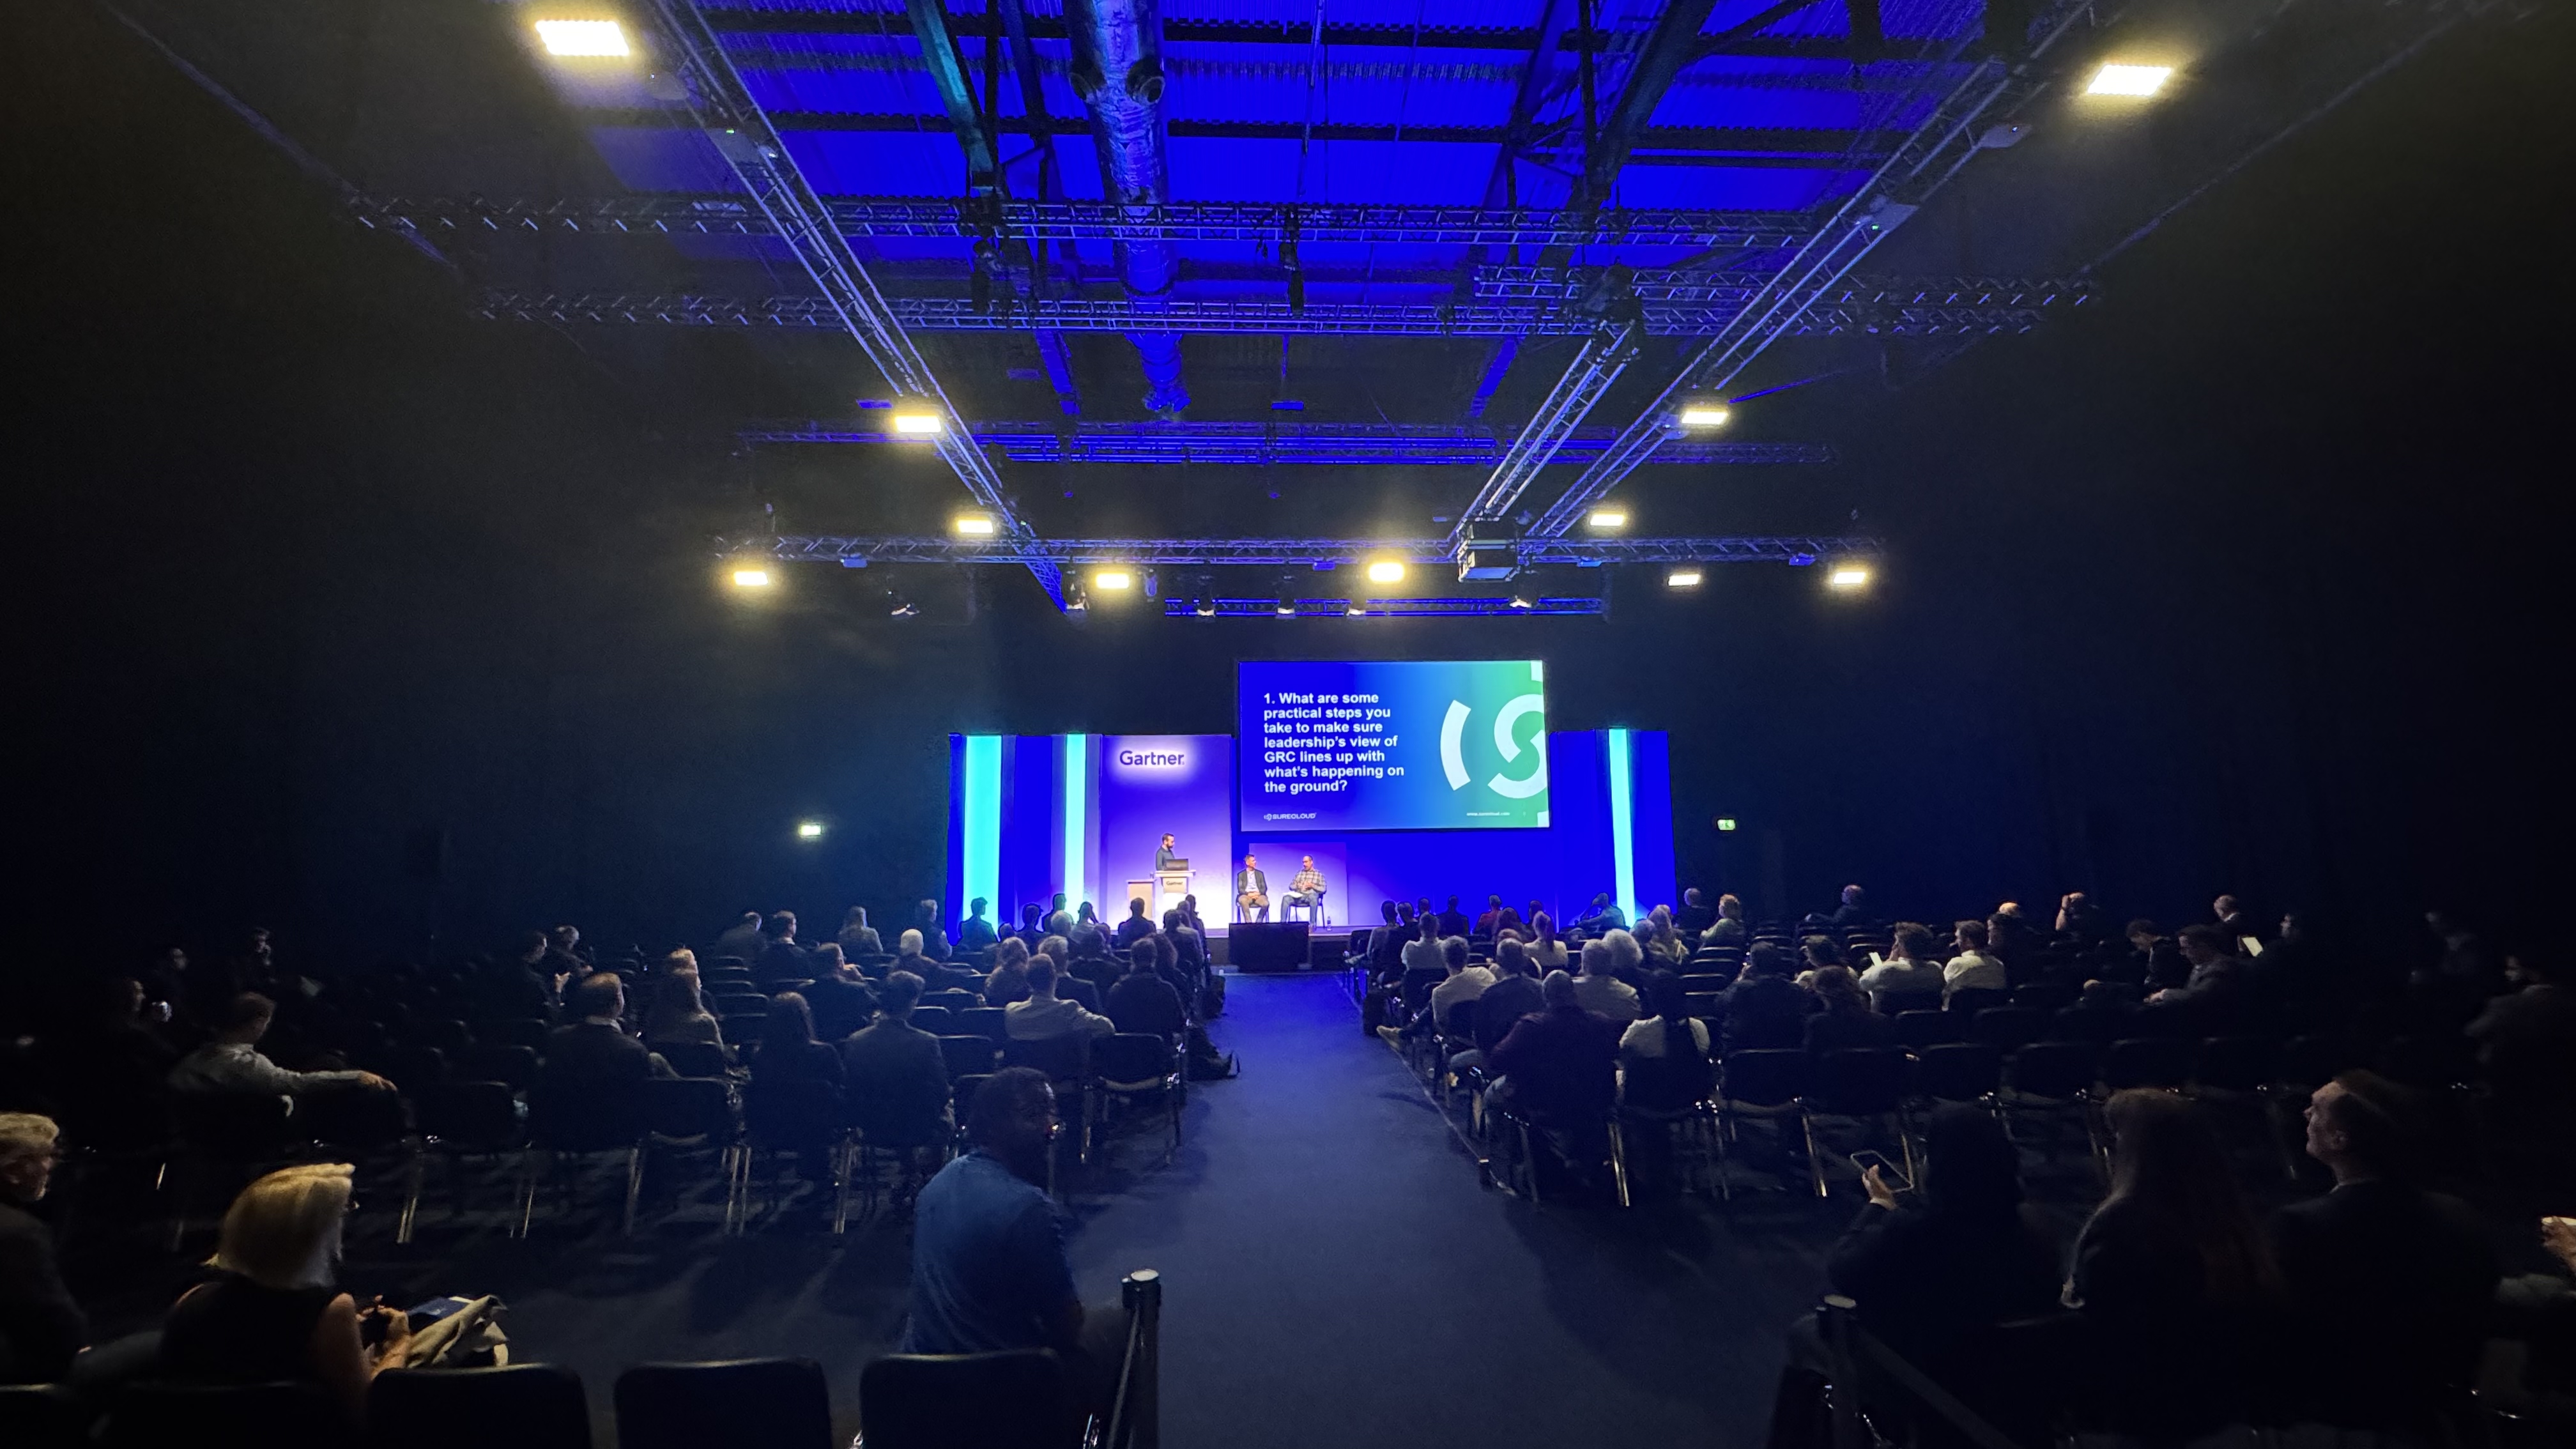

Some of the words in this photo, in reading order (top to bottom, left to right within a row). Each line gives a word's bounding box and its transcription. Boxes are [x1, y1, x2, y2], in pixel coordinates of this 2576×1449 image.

[1264, 693, 1275, 703] 1.
[1279, 693, 1314, 703] What
[1317, 694, 1338, 703] are
[1342, 694, 1379, 703] some
[1264, 707, 1321, 721] practical
[1325, 707, 1362, 721] steps
[1366, 709, 1391, 720] you
[1264, 722, 1292, 733] take
[1296, 723, 1310, 733] to
[1314, 721, 1349, 733] make
[1353, 723, 1383, 732] sure
[1349, 736, 1381, 747] view
[1384, 735, 1398, 747] of
[1119, 750, 1184, 765] Gartner
[1264, 751, 1296, 763] GRC
[1300, 751, 1332, 762] lines
[1336, 753, 1353, 764] up
[1356, 750, 1385, 762] with
[1312, 765, 1383, 779] happening
[1387, 767, 1404, 776] on
[1264, 781, 1286, 792] the
[1290, 779, 1347, 795] ground?
